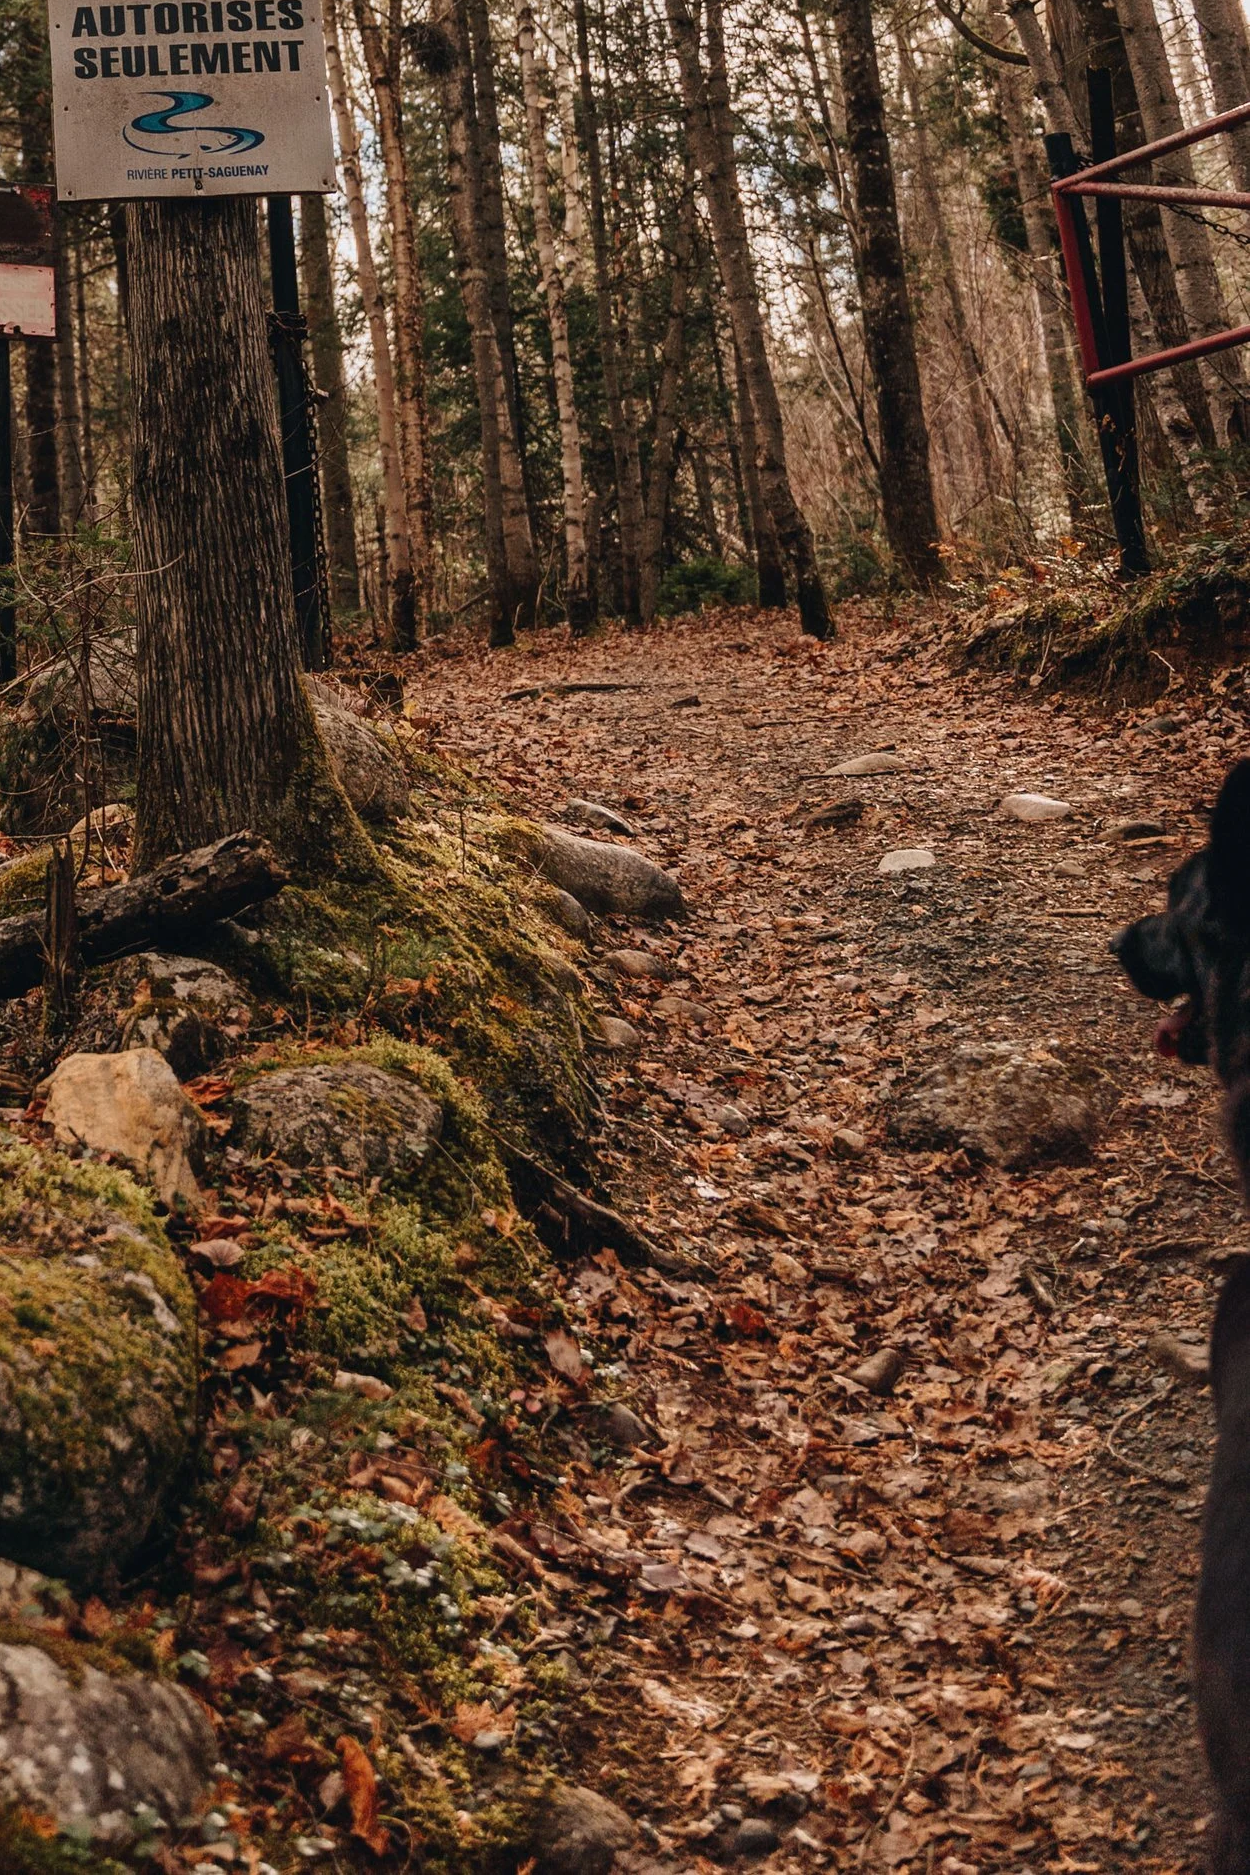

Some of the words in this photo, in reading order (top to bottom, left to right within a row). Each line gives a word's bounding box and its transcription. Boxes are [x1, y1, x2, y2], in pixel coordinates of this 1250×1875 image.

[73, 40, 305, 80] SEULEMENT
[126, 166, 169, 181] RIVIÈRE
[171, 164, 270, 180] PETIT-SAGUENAY
